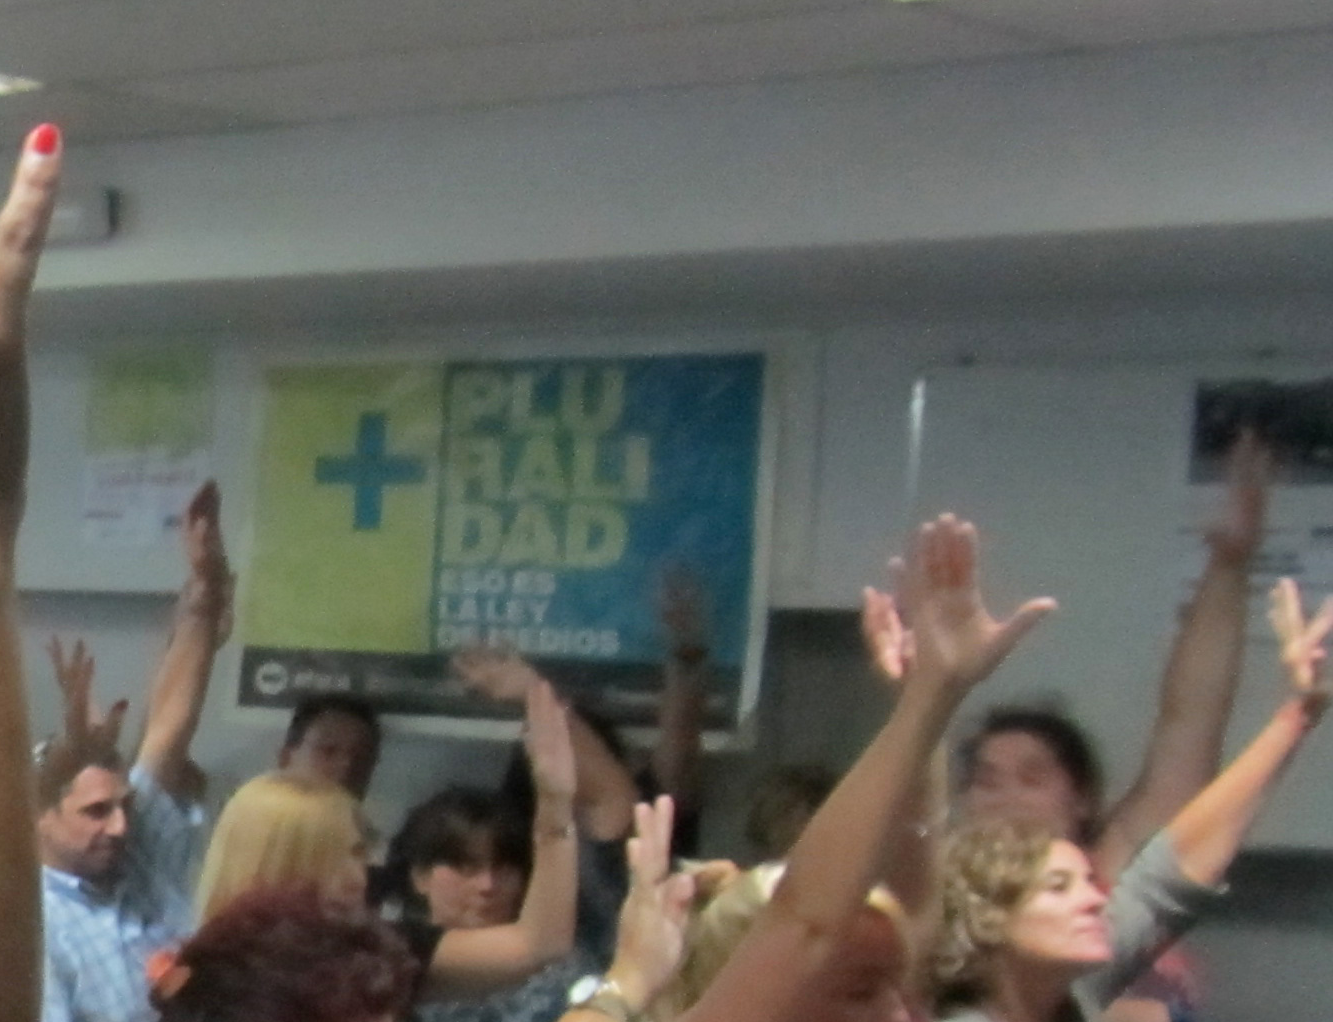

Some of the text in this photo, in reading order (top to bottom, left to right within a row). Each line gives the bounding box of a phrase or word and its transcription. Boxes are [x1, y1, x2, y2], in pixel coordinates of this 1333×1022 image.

[445, 366, 626, 436] PLU
[442, 433, 650, 502] RALI
[439, 500, 629, 567] DAD
[440, 569, 556, 595] ESO ES
[438, 596, 550, 623] LA LEY
[487, 626, 621, 657] MEDIOS
